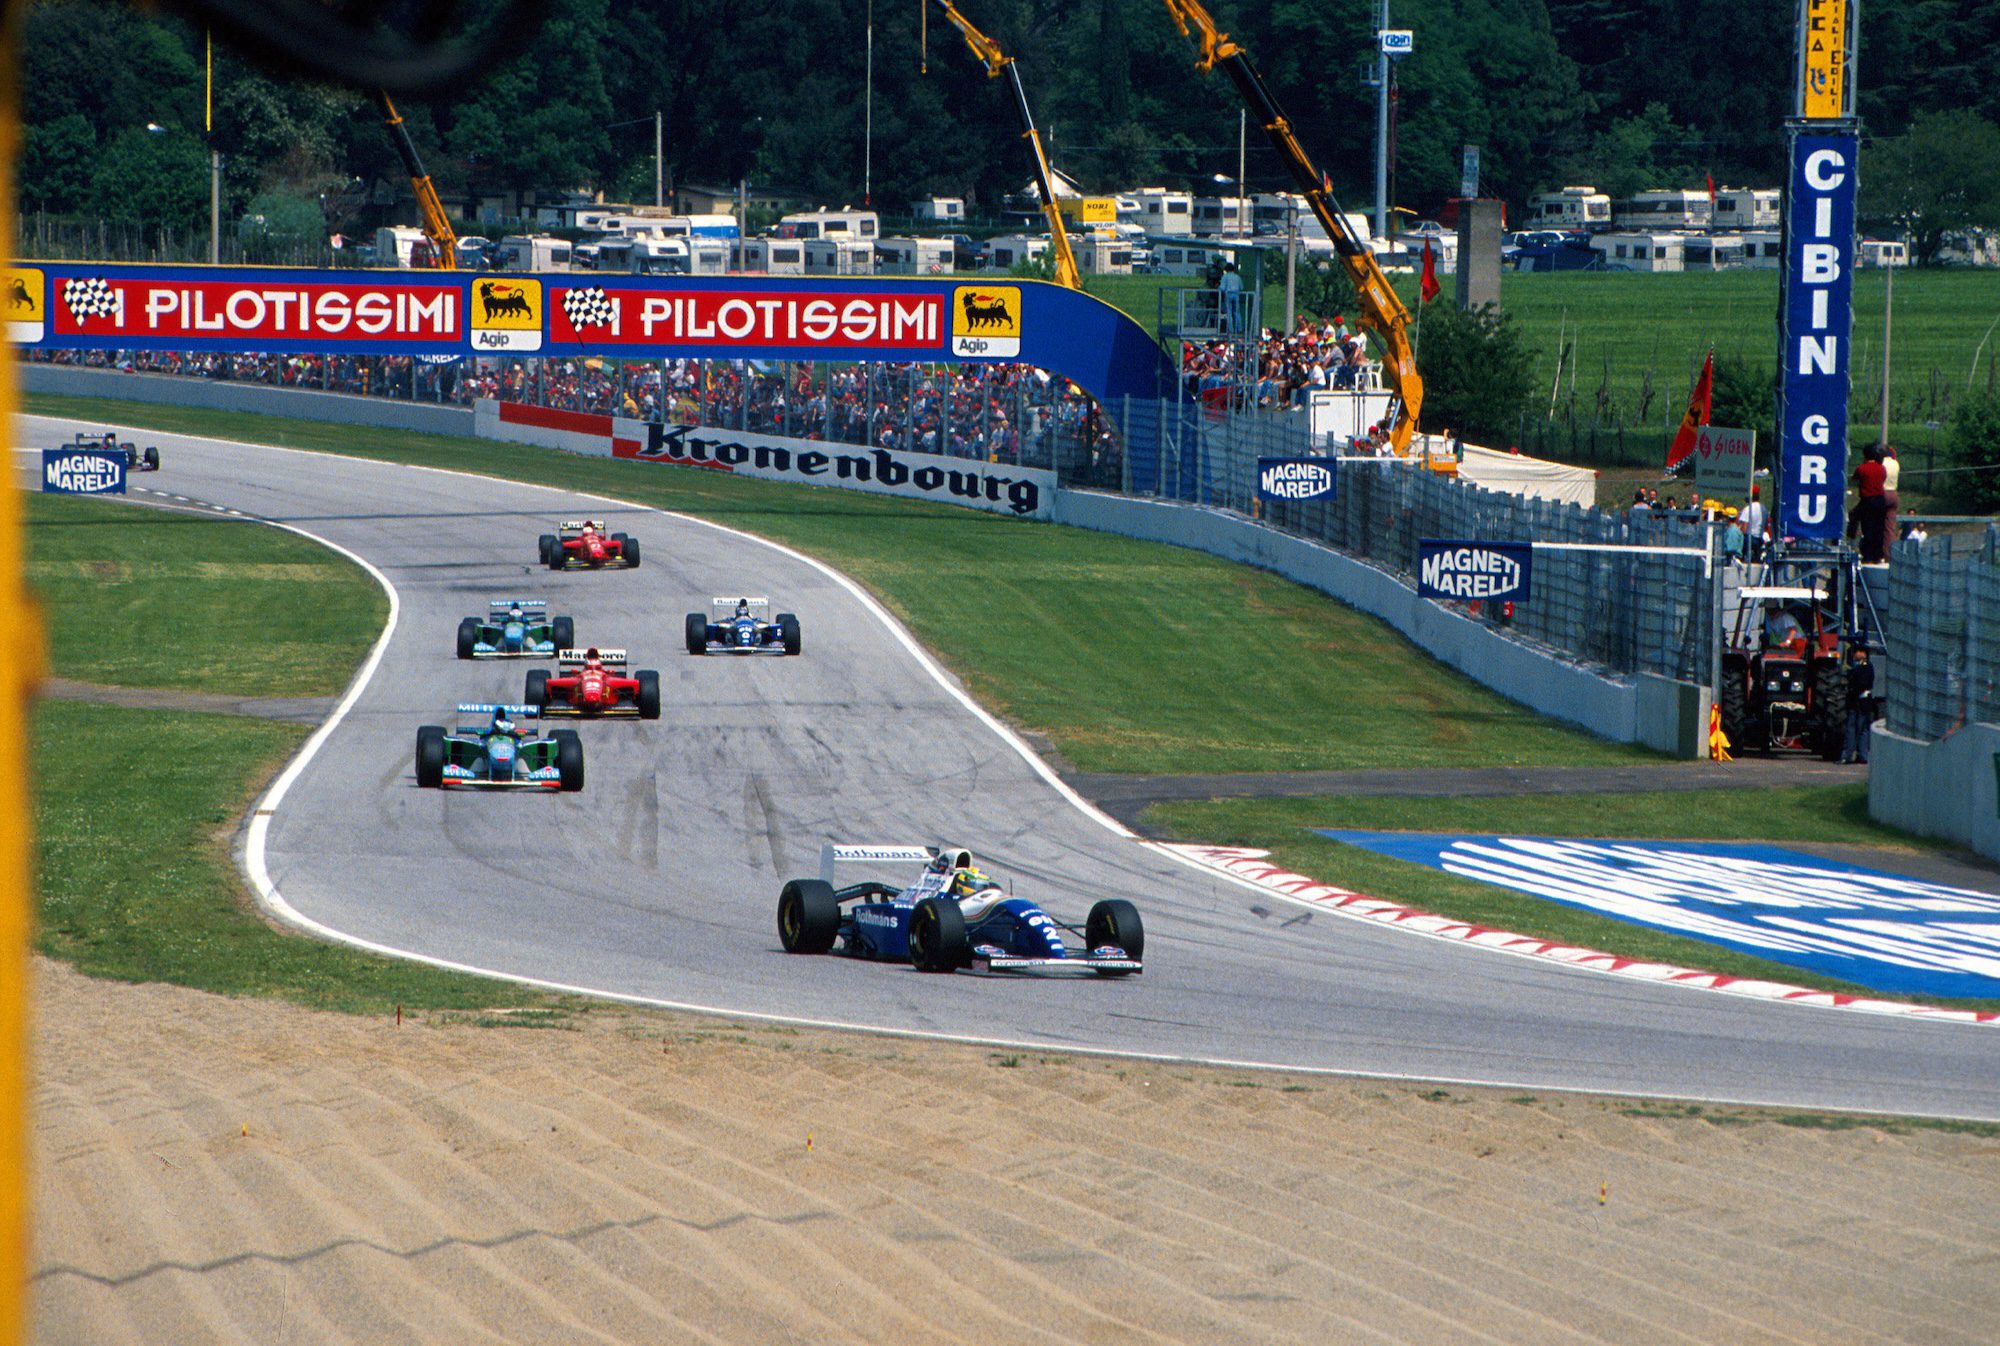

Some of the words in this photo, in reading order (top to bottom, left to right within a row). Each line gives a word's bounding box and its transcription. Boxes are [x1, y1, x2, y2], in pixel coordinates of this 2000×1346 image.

[1799, 149, 1845, 375] CIBIN
[145, 289, 454, 333] PILOTISSIMI
[640, 298, 937, 340] PILOTISSIMI
[479, 331, 509, 347] Agip
[959, 338, 988, 353] Agip
[47, 455, 119, 478] MAGNETI
[636, 422, 1039, 514] Kronenbourg
[1262, 463, 1331, 485] MAGNETI
[1798, 414, 1830, 524] GRU
[47, 468, 119, 491] MARELLI
[1262, 476, 1331, 498] MARELLI
[1422, 548, 1520, 580] MAGNETI
[1422, 566, 1520, 597] MARELLI
[855, 907, 898, 928] Rothmans
[1043, 926, 1060, 941] 2
